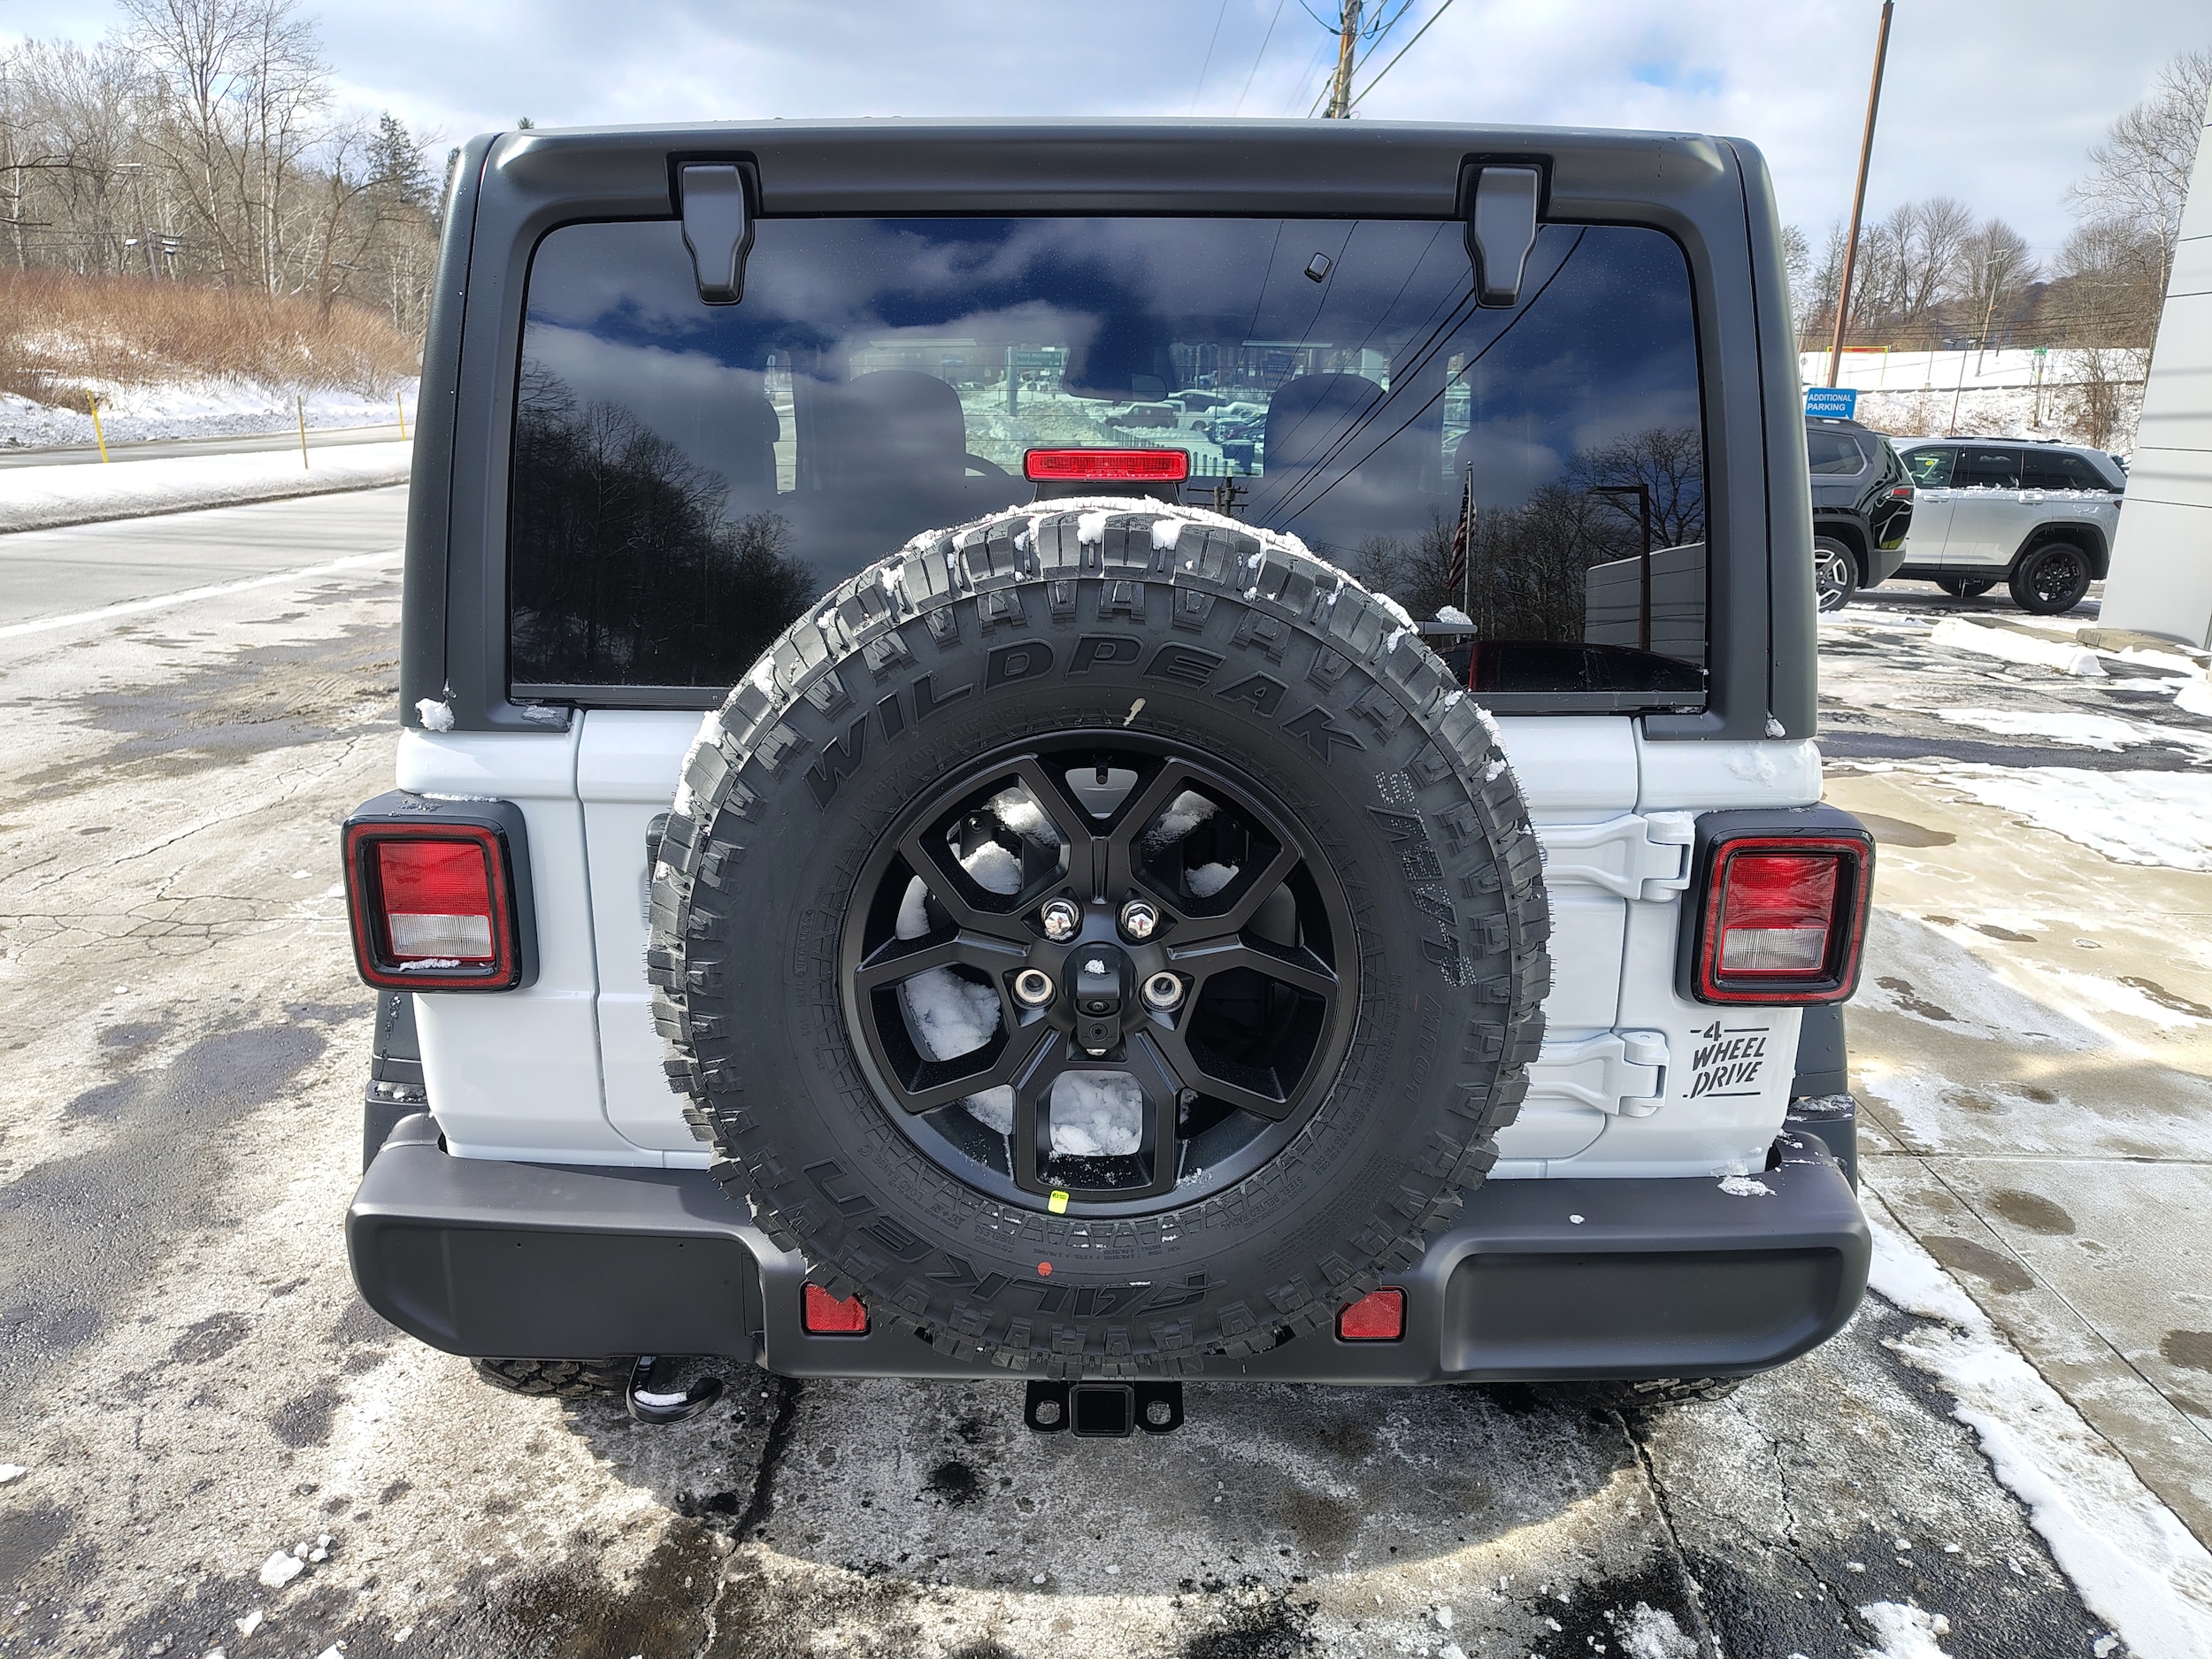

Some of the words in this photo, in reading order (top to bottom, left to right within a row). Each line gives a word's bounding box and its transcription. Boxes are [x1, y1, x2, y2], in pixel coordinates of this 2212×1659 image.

[801, 633, 1367, 814] WILDPEAK
[1703, 1021, 1722, 1041] 4
[1692, 1037, 1767, 1071] WHEEL
[1689, 1061, 1763, 1099] DRIVE
[871, 1154, 901, 1182] RANGE
[897, 1179, 925, 1202] LOAD
[1278, 1175, 1305, 1198] STEEL
[1248, 1194, 1280, 1217] BELTED
[1219, 1212, 1249, 1233] RADIAL
[803, 1156, 1227, 1317] FALKEN
[972, 1223, 1018, 1246] TUBELESS
